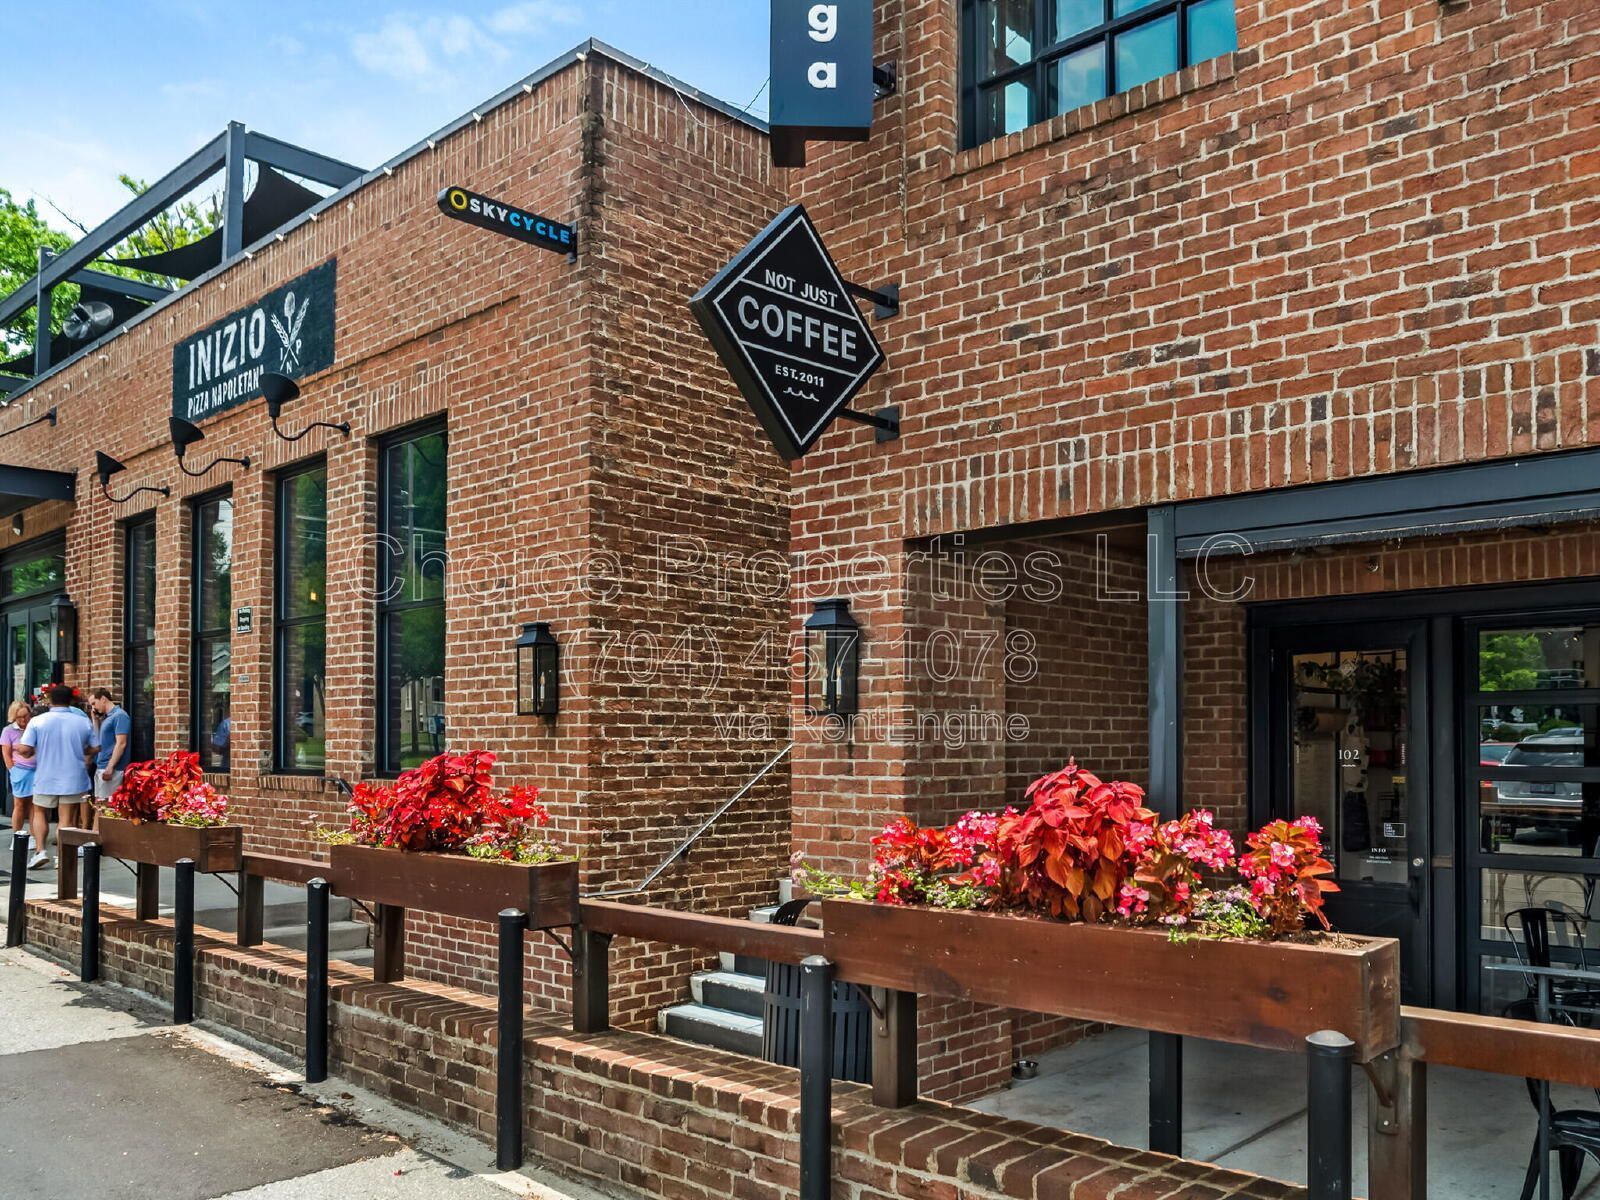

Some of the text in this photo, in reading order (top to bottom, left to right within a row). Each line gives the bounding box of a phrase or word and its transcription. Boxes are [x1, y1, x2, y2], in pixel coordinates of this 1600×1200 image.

[765, 269, 837, 308] NOT JUST
[737, 295, 858, 362] COFFEE
[188, 308, 266, 390] INIZIO
[187, 388, 209, 418] PIZZA
[1338, 749, 1360, 760] 102
